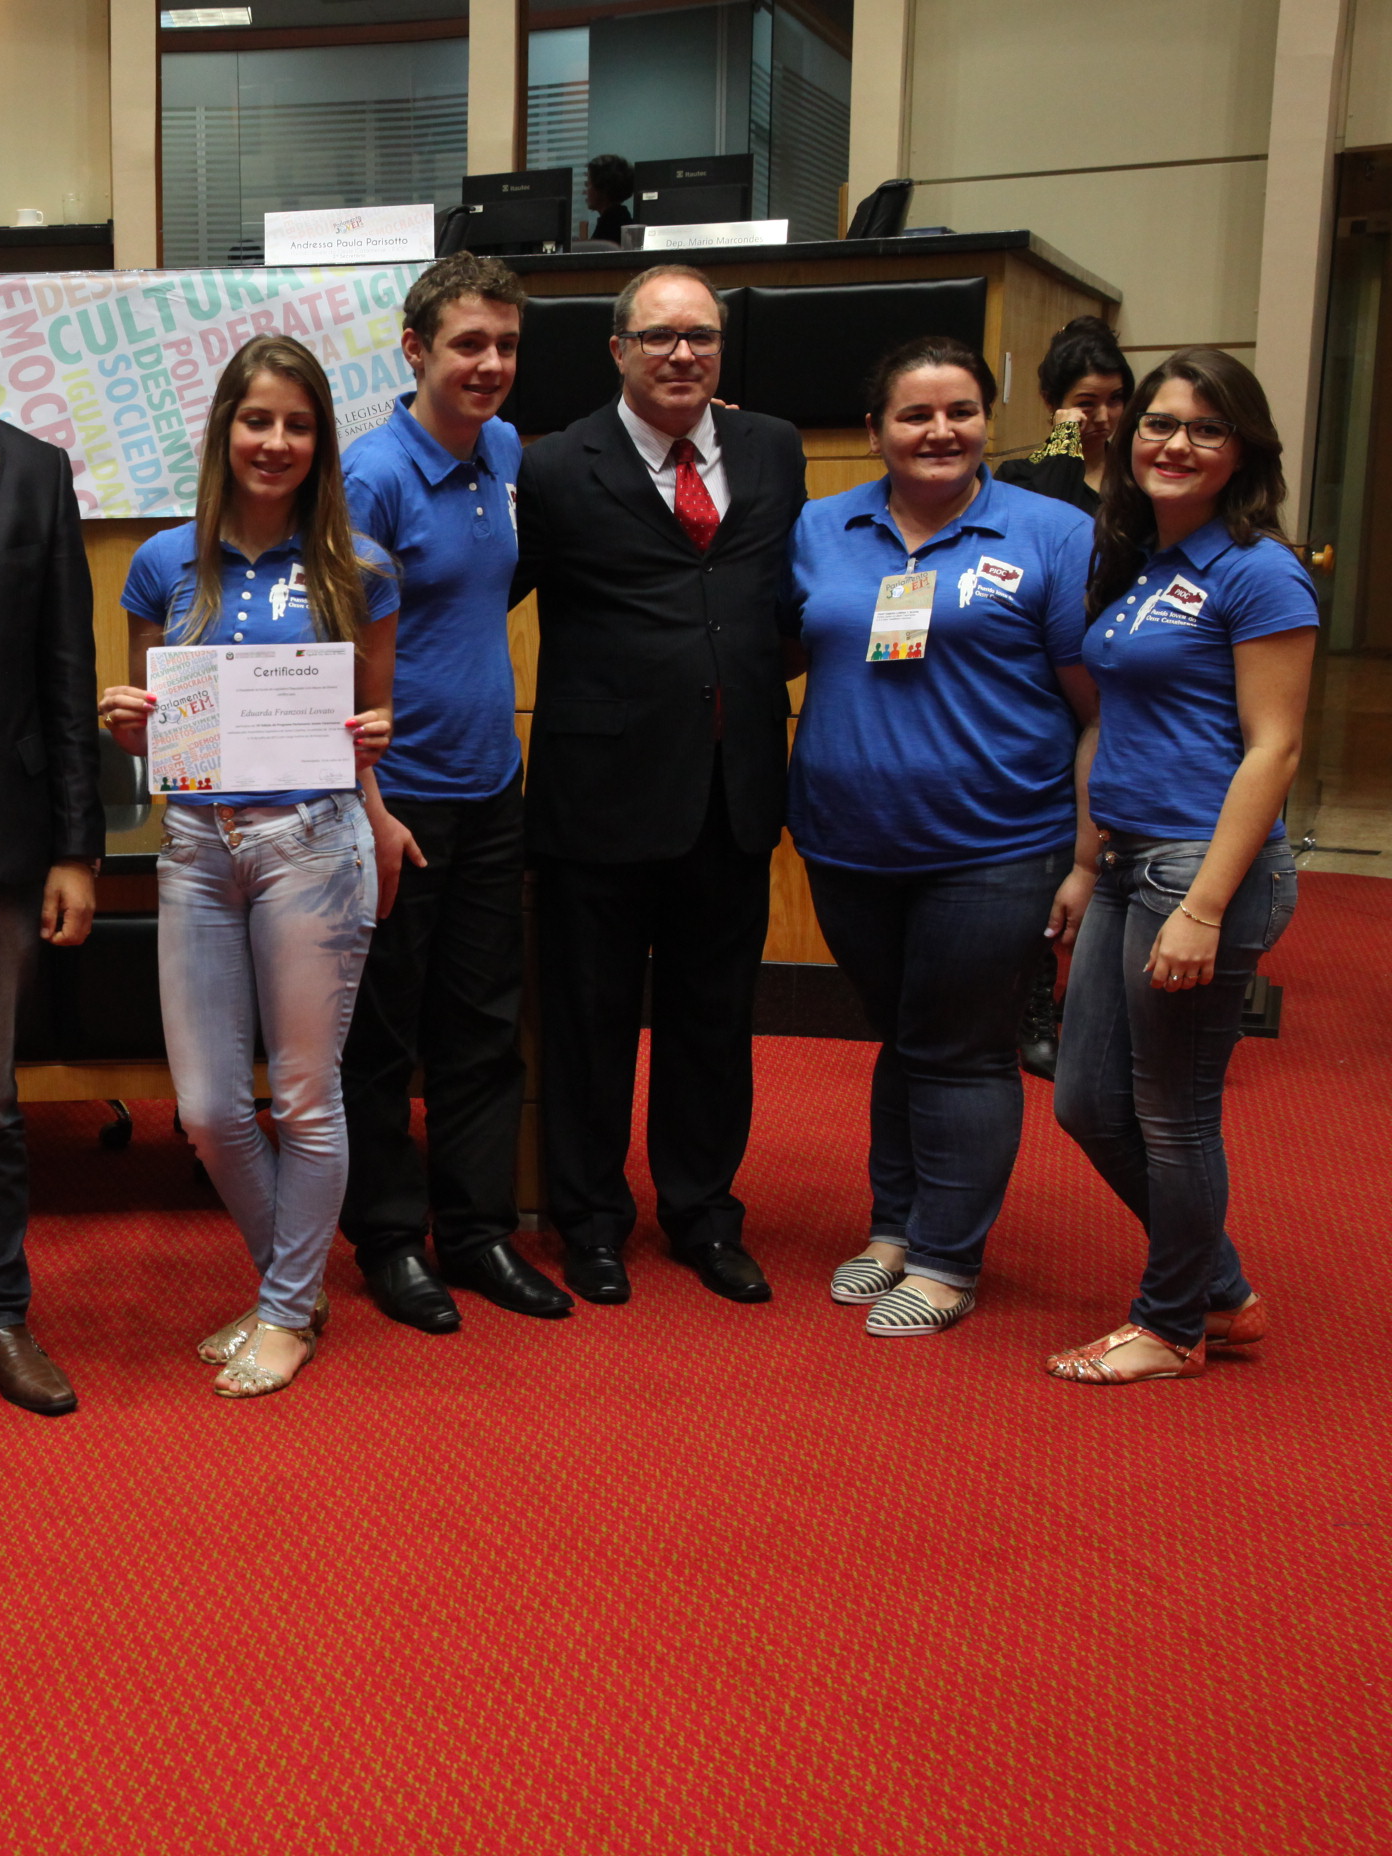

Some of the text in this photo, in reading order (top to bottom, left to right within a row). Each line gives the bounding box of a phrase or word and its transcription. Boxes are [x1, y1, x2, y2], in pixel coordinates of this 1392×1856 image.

[290, 237, 408, 249] Andressa Paula Parisotto
[665, 235, 764, 247] Dep. Mario Marcondes
[48, 267, 305, 365] CULTURA
[199, 285, 355, 367] DEBATE
[345, 421, 374, 437] SANTA
[253, 666, 319, 677] Certificado
[240, 709, 272, 718] Eduarda
[309, 707, 335, 716] Lovato
